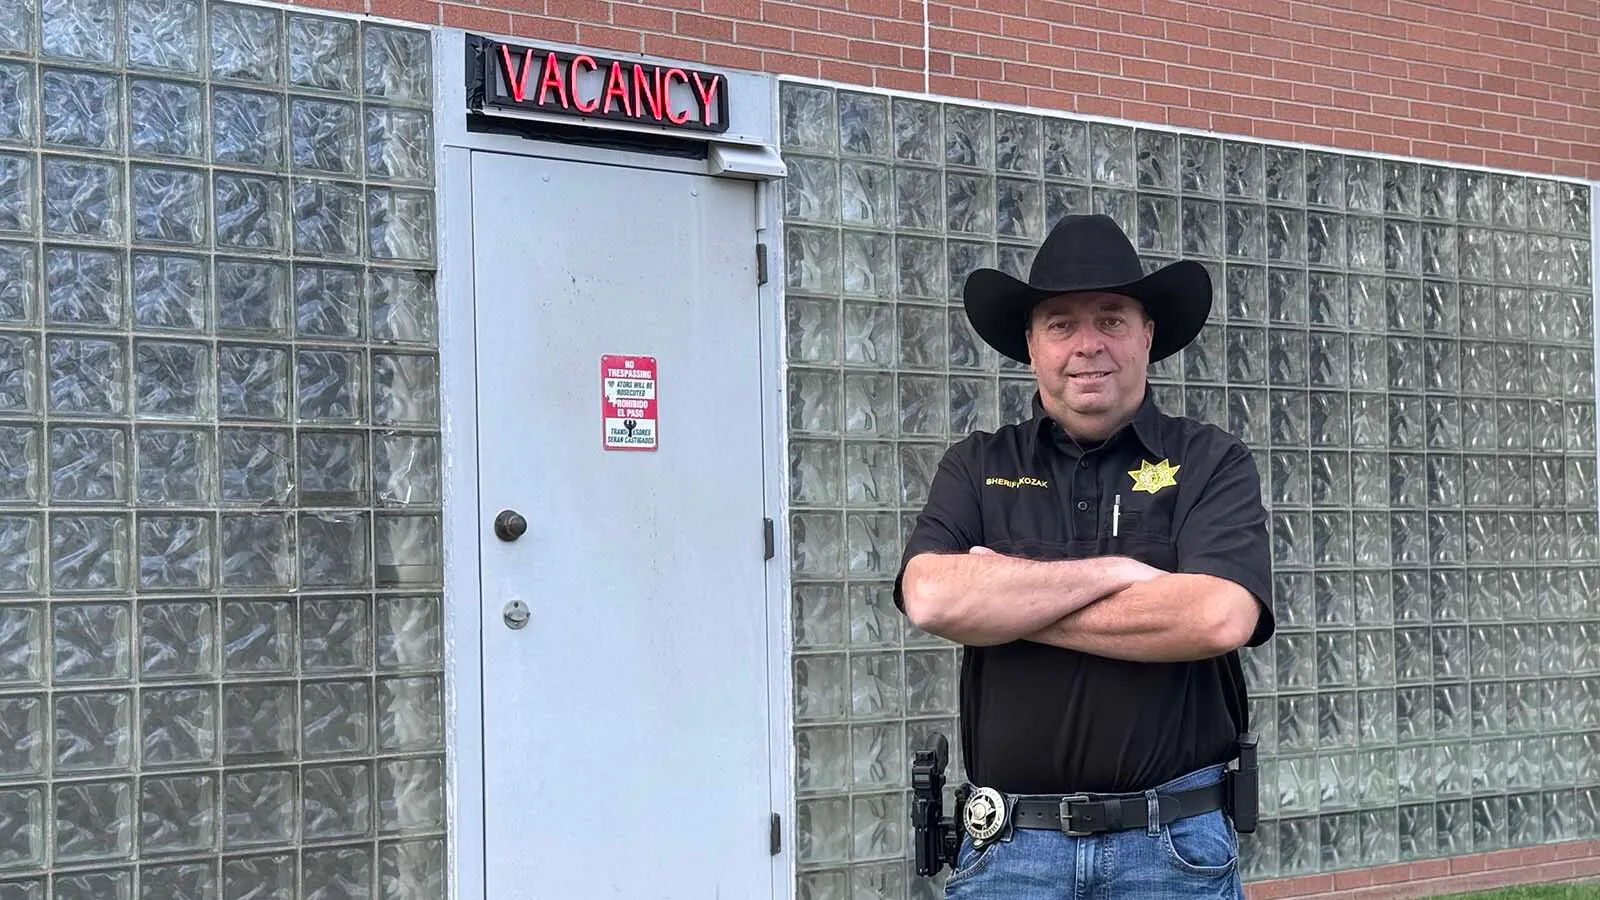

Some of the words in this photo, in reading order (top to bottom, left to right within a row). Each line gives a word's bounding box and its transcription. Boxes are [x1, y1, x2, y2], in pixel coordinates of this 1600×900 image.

[501, 44, 719, 127] VACANCY
[625, 360, 634, 368] NO
[608, 368, 652, 379] TRESPASSING
[633, 381, 645, 389] WILL
[616, 389, 645, 397] ROSECUTED
[617, 408, 626, 417] EL
[626, 408, 645, 418] PASO
[610, 427, 652, 436] TRANSESORES
[1018, 476, 1049, 489] KOZAK
